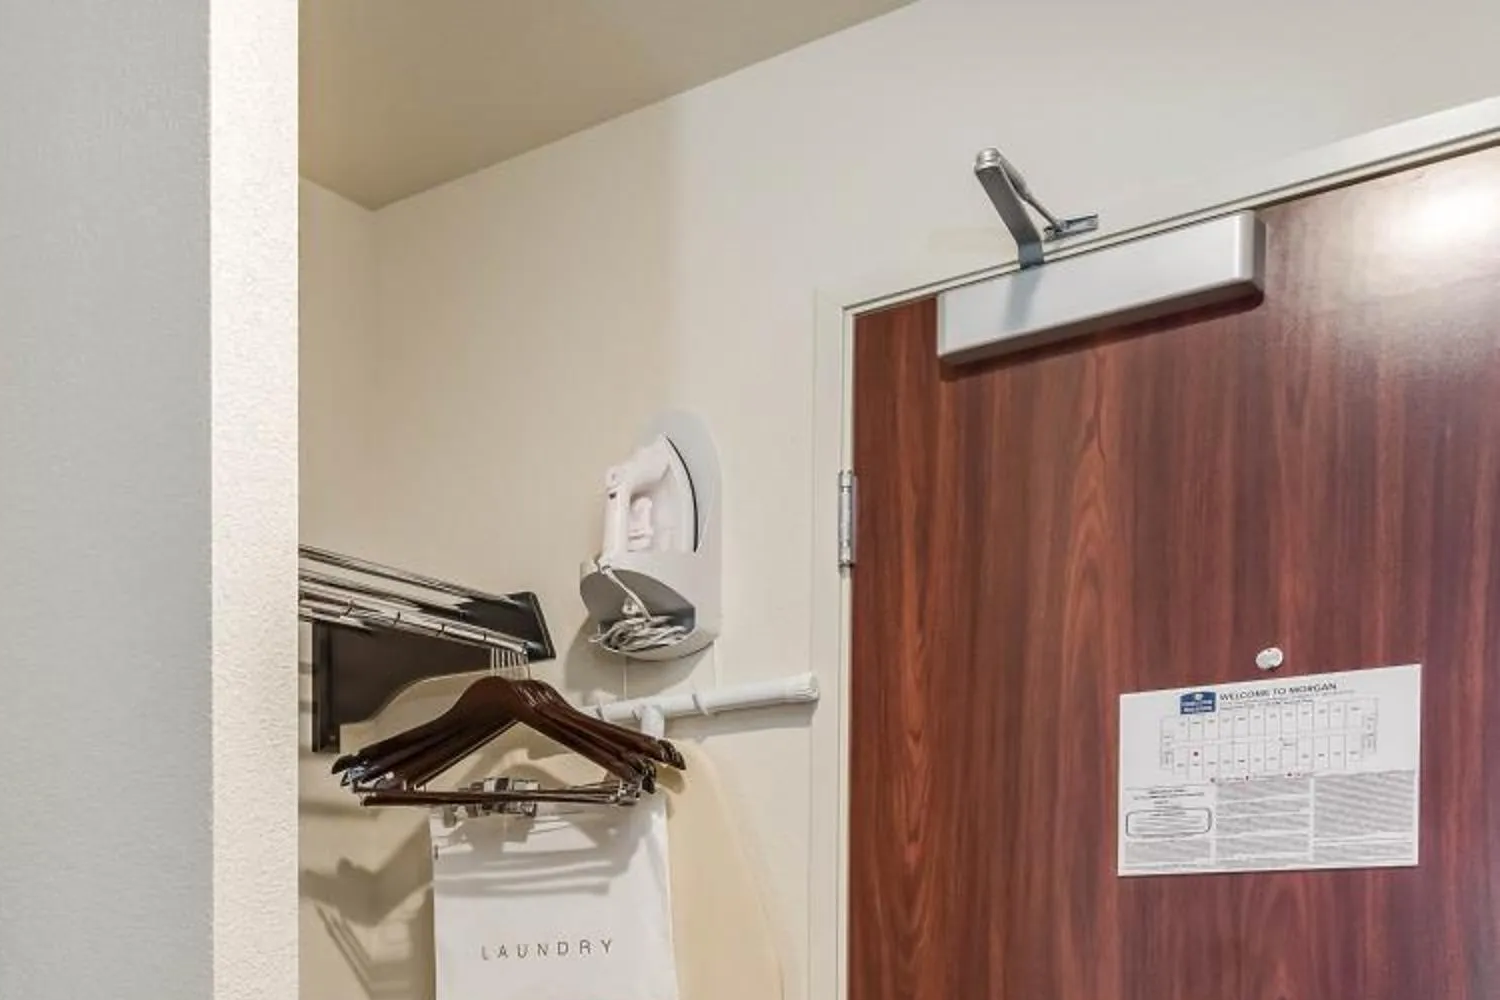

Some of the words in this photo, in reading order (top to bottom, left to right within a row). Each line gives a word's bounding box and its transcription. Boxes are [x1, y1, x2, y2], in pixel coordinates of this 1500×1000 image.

[1220, 688, 1270, 701] WELCOME
[1273, 687, 1286, 696] TO
[1289, 683, 1337, 695] MORGAN
[480, 939, 614, 960] LAUNDRY
